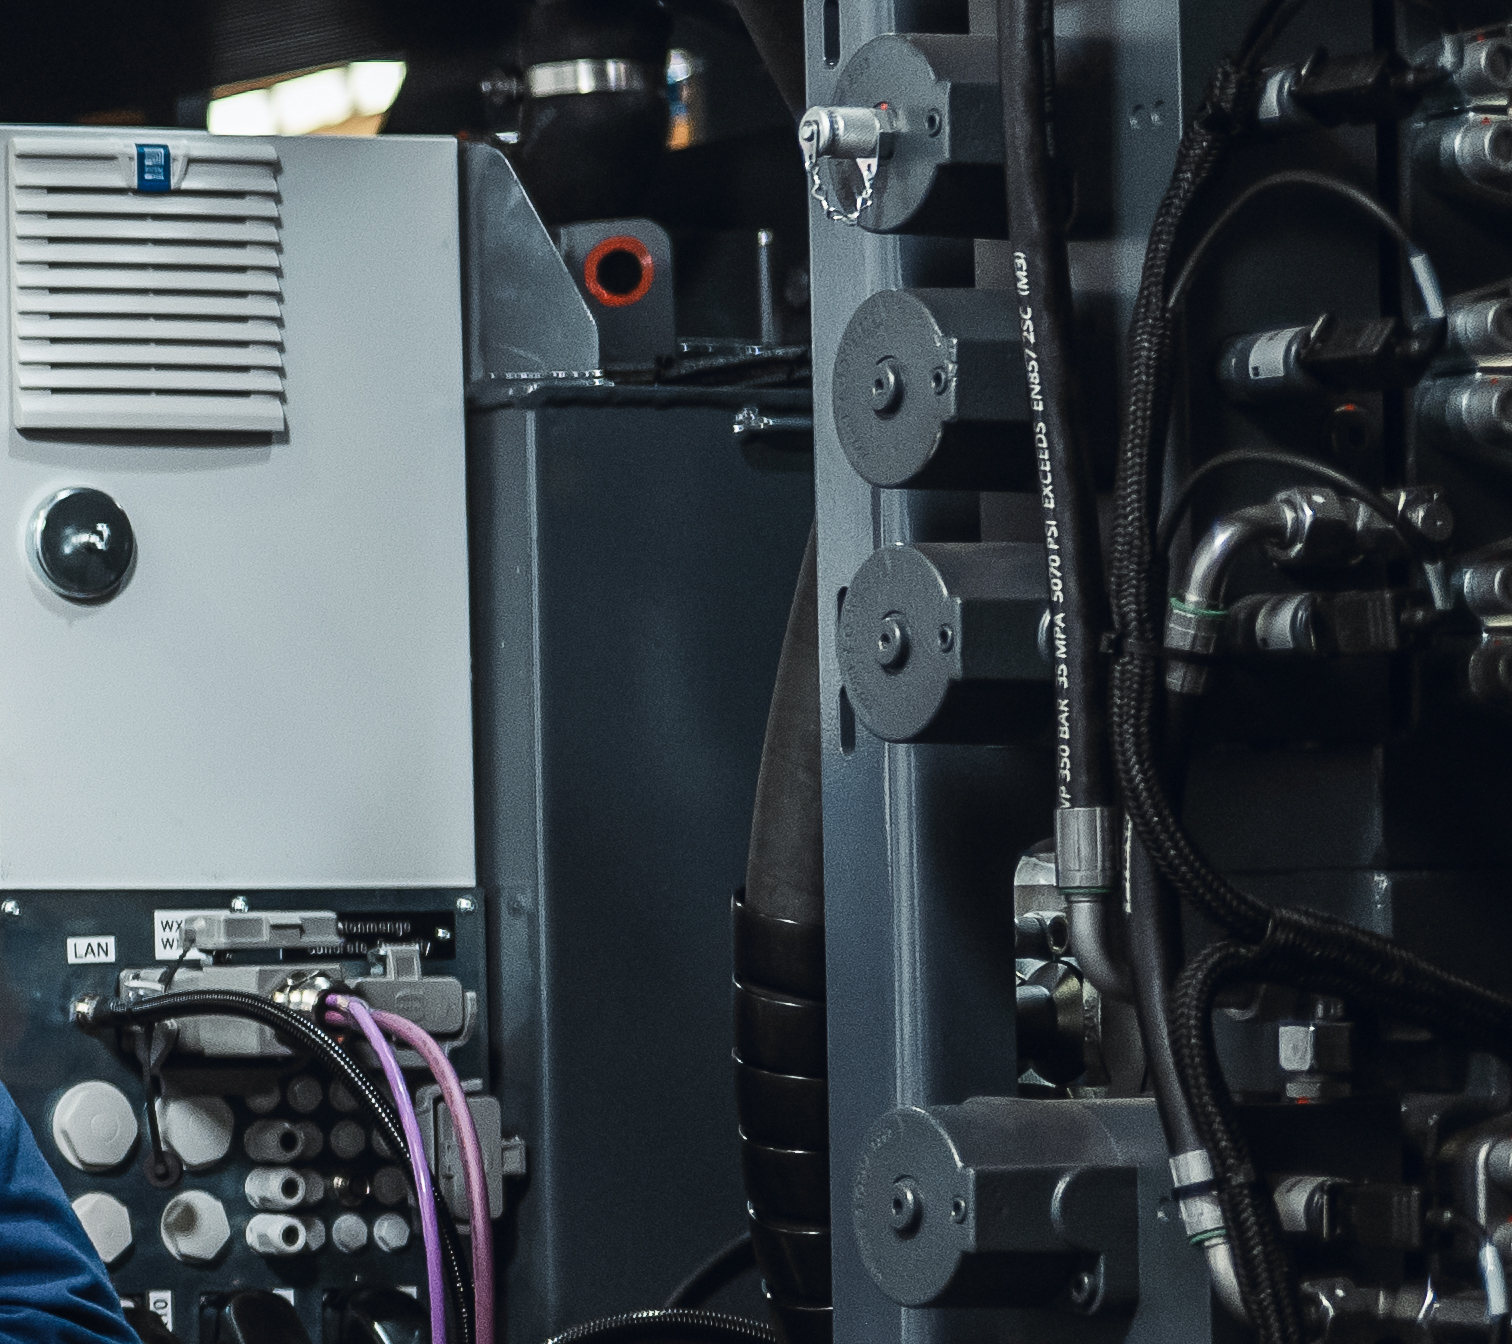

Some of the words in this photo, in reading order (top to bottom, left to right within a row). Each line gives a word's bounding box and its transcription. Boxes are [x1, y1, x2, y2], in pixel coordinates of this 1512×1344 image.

[1012, 251, 1031, 296] (M3)
[1018, 306, 1036, 344] 2SC
[1023, 347, 1045, 412] EN857
[1033, 421, 1056, 509] EXCEEDS
[1043, 519, 1061, 551] PSI
[1047, 553, 1065, 605] 5070
[1052, 611, 1068, 660] MPA
[1054, 663, 1069, 689] 35
[1056, 698, 1071, 740] BAR
[1057, 745, 1072, 783] 350
[73, 942, 109, 958] LAN
